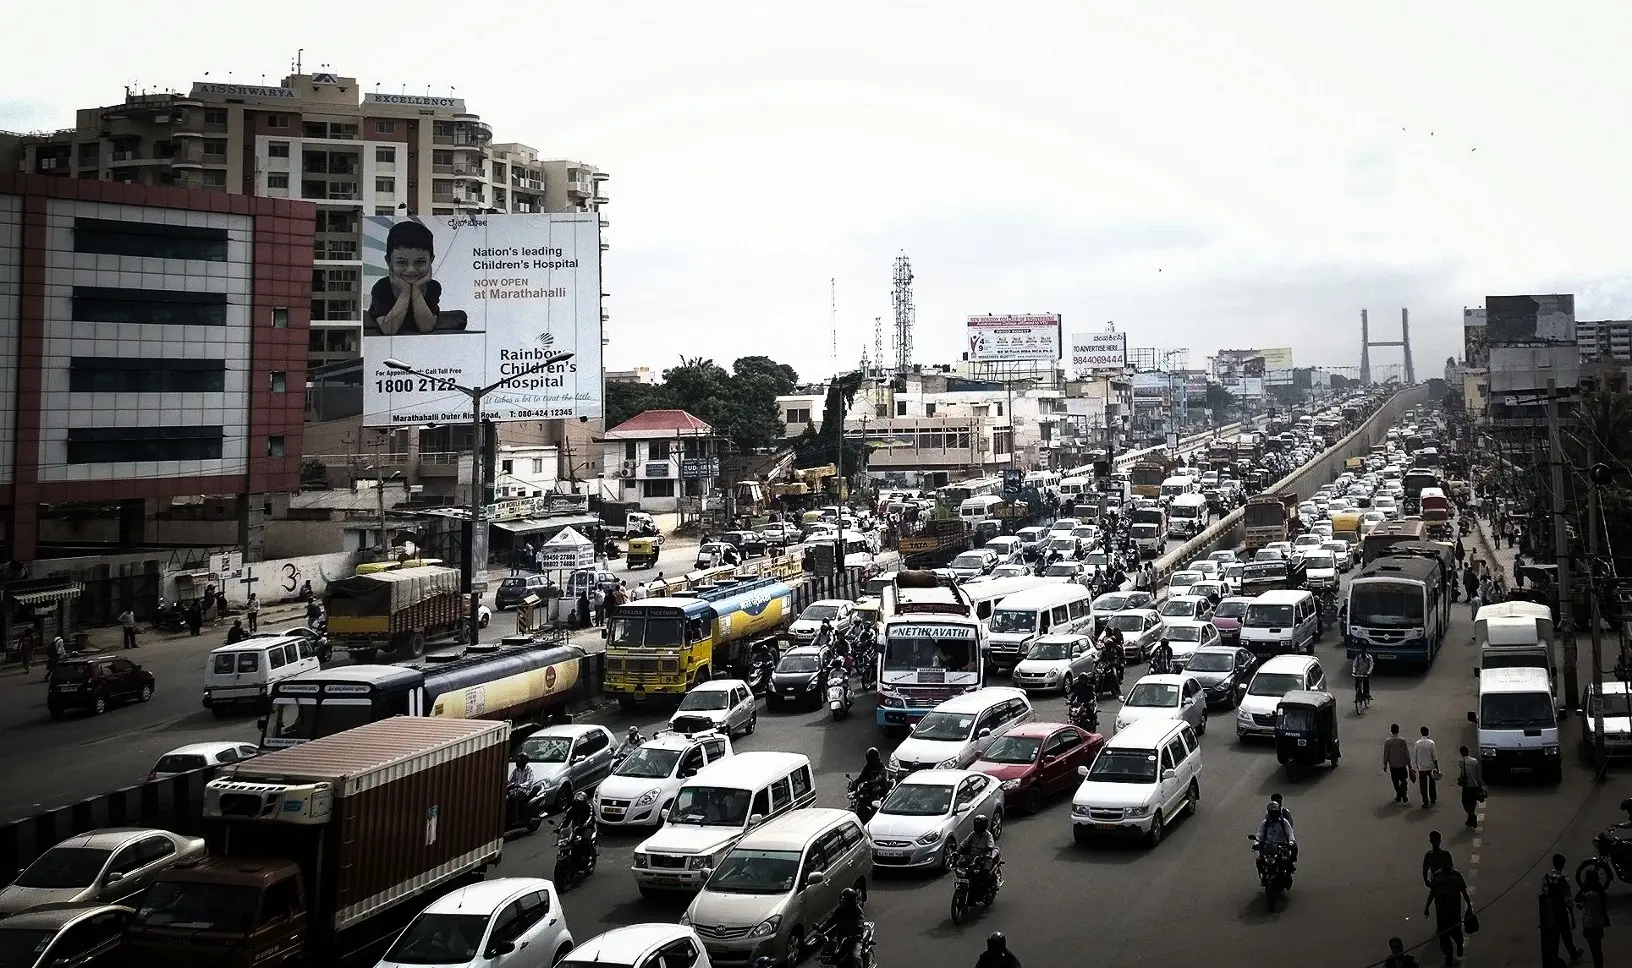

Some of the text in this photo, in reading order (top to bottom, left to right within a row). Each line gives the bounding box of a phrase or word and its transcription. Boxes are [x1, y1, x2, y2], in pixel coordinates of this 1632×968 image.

[201, 84, 295, 98] AISSHWARYA
[374, 94, 455, 107] EXCELLENCY
[472, 246, 563, 257] Nation's leading
[472, 258, 579, 270] Children's Hospital
[473, 278, 529, 287] NOW OPEN
[474, 287, 566, 300] at Marathahalli
[375, 377, 456, 393] 1800 2122
[500, 375, 564, 390] Hospital
[392, 413, 439, 422] Marathahalli
[441, 412, 460, 421] Outer
[462, 411, 475, 419] Rin
[480, 411, 501, 419] Road,
[518, 410, 548, 418] 080-424
[551, 408, 573, 416] 12345
[909, 541, 928, 549] TATA
[898, 627, 970, 638] NETHRAVATHI
